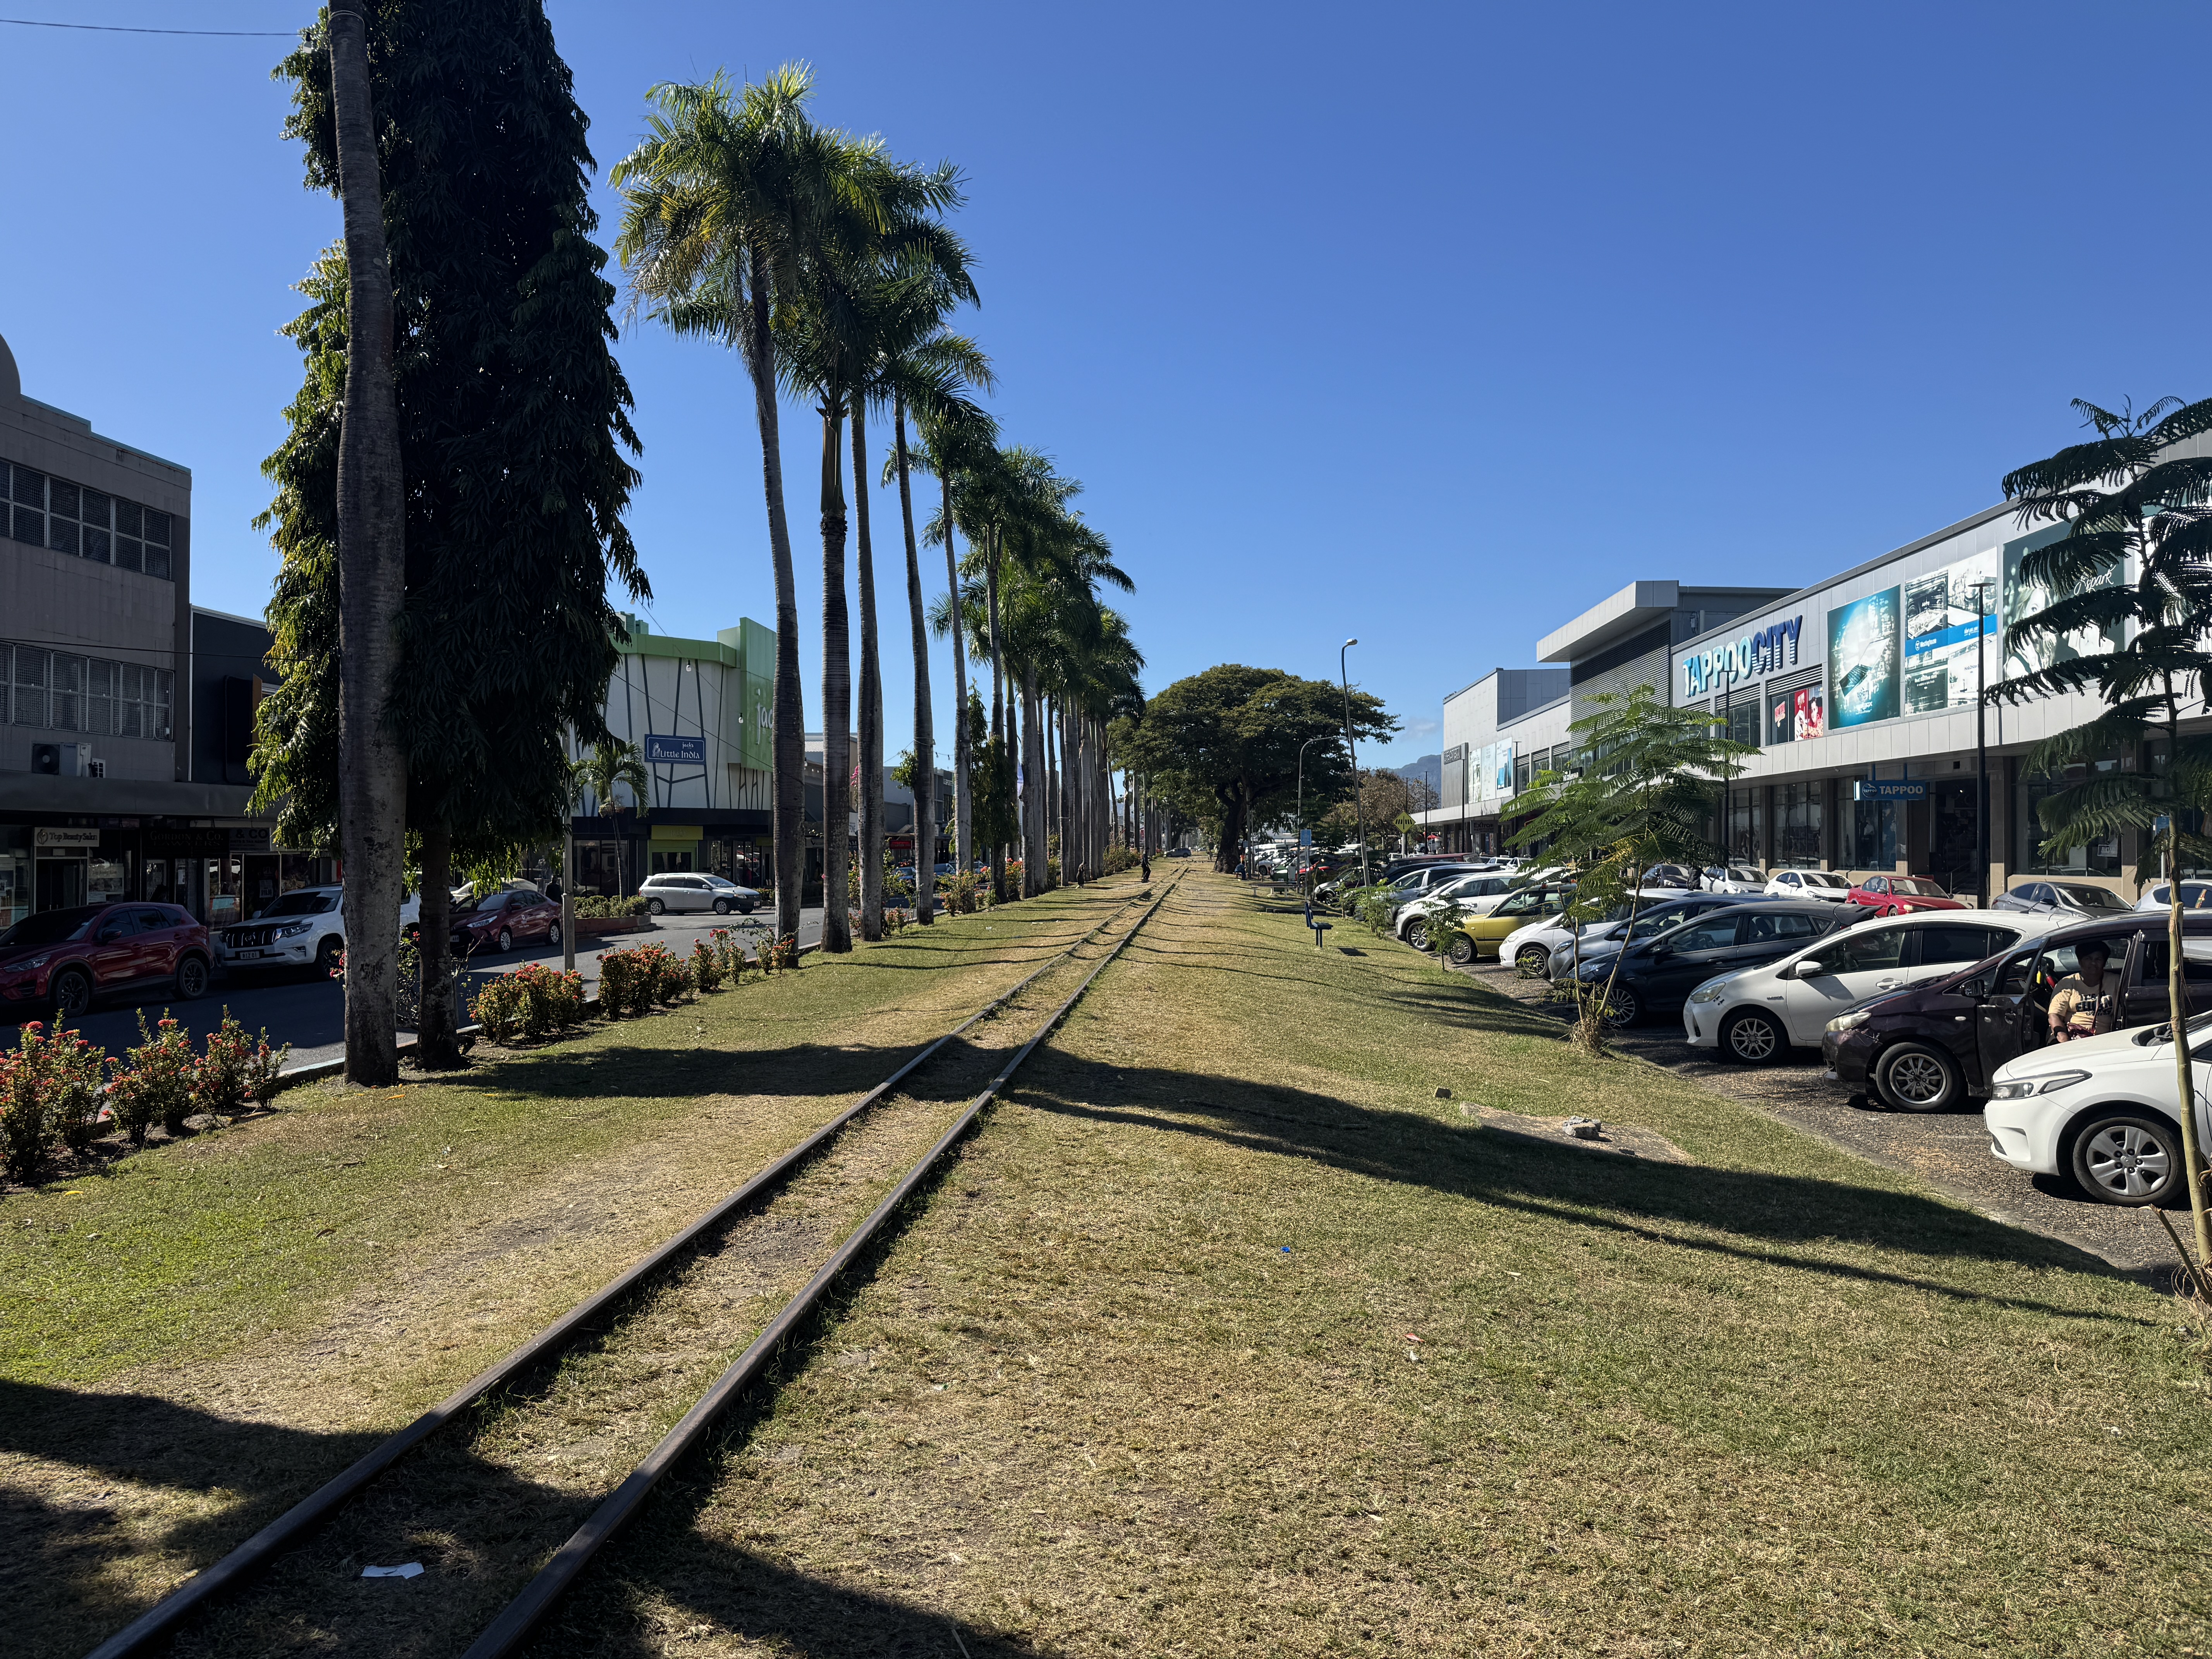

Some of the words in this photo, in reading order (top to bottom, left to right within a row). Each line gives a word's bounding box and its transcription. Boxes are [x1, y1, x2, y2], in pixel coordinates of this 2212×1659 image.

[1879, 785, 1923, 795] TAPPOO
[49, 833, 62, 842] Top
[150, 830, 191, 840] GORDON
[236, 829, 245, 838] &
[249, 829, 268, 839] CO
